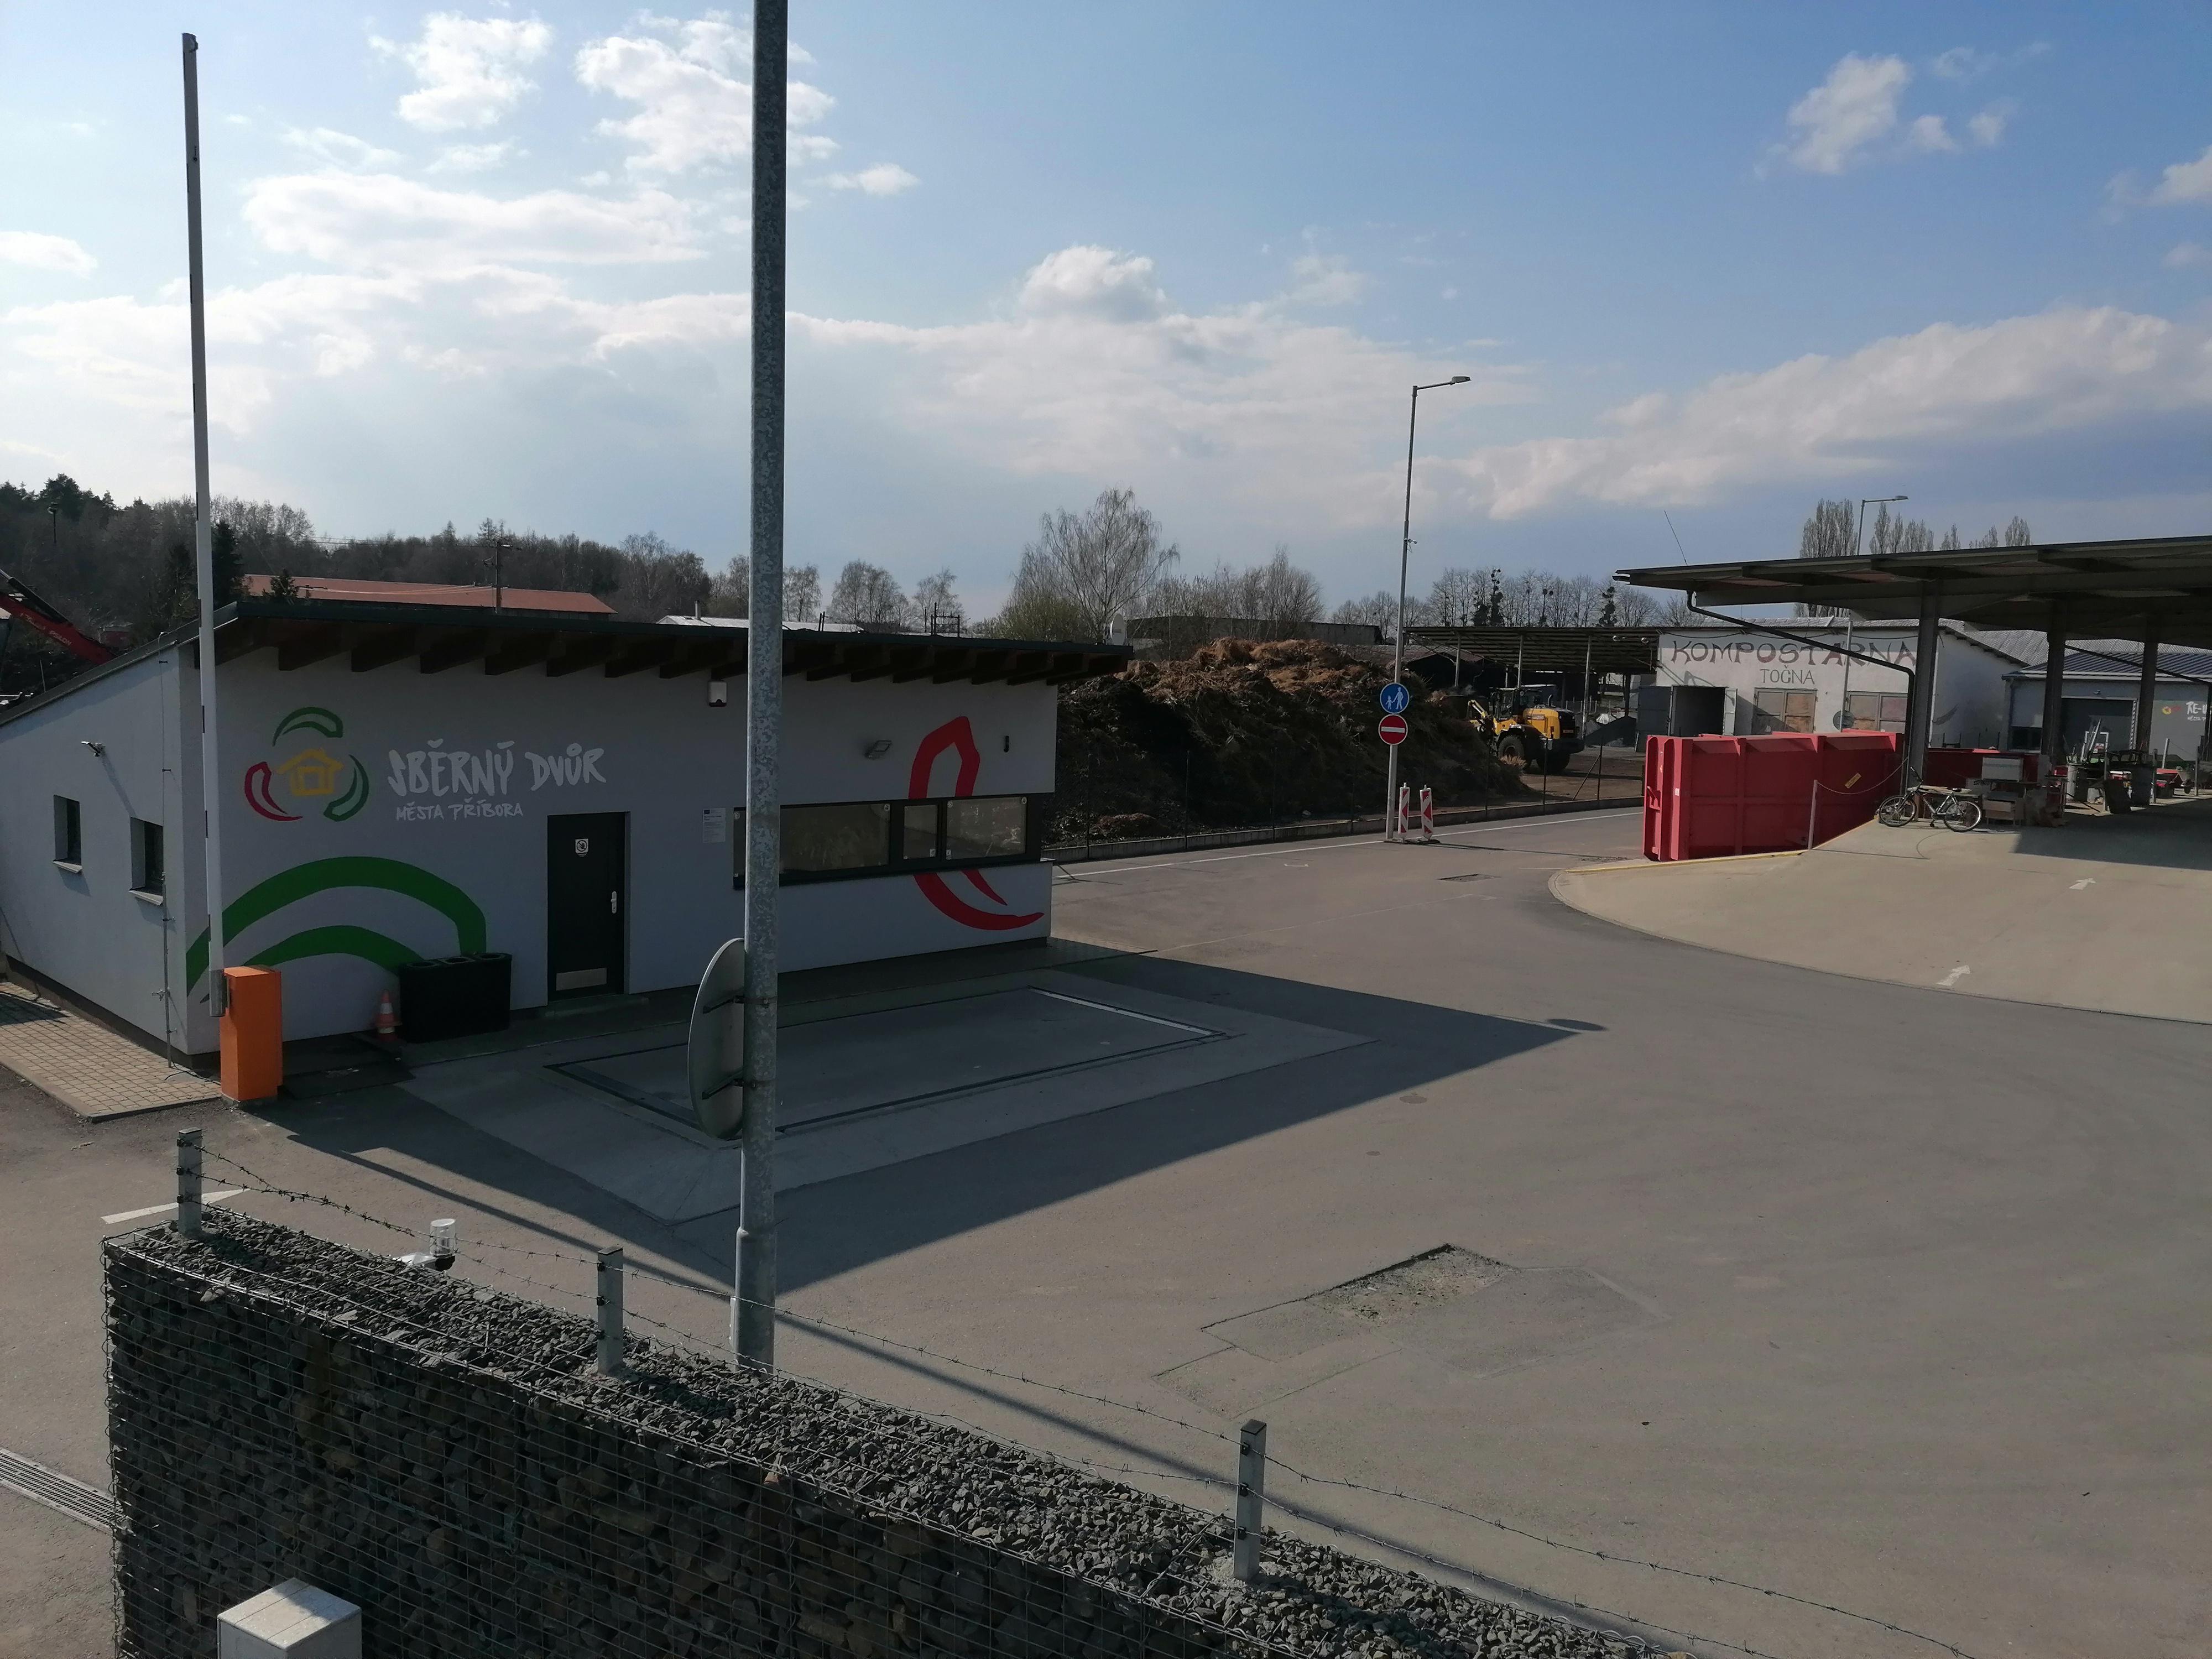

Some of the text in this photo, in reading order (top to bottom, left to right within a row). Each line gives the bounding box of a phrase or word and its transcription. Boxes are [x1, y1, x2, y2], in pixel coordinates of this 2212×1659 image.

[1760, 665, 1815, 685] TOČNA
[388, 738, 607, 796] SBĚRNÝ DVŮR
[396, 797, 523, 821] MĚSTA PŘÍBORA
